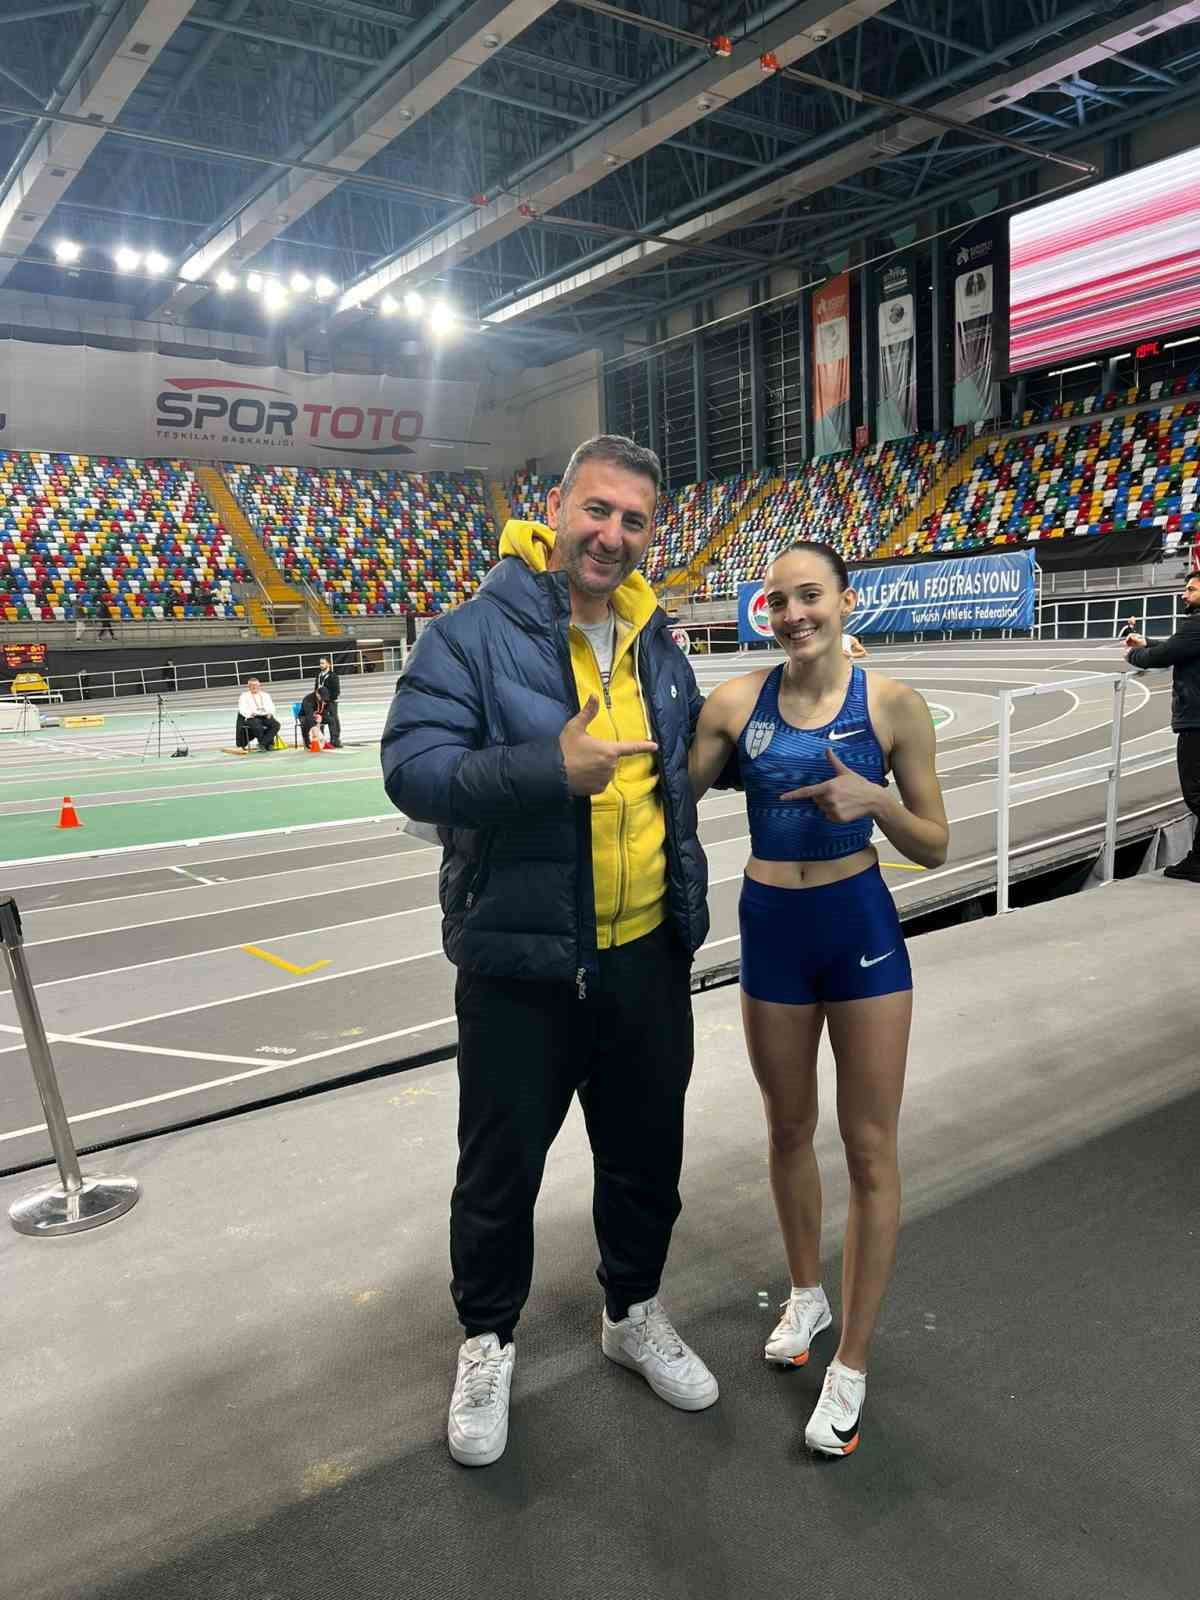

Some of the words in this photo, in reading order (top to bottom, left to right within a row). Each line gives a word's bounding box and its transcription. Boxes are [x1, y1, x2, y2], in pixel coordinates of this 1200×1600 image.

[156, 391, 298, 436] SPOR
[303, 403, 424, 441] TOTO
[856, 577, 919, 606] ATLETİZM
[924, 569, 1021, 599] FEDERASYONU
[912, 610, 940, 624] Turkish
[942, 607, 973, 621] Athletic
[975, 604, 1018, 620] Federation
